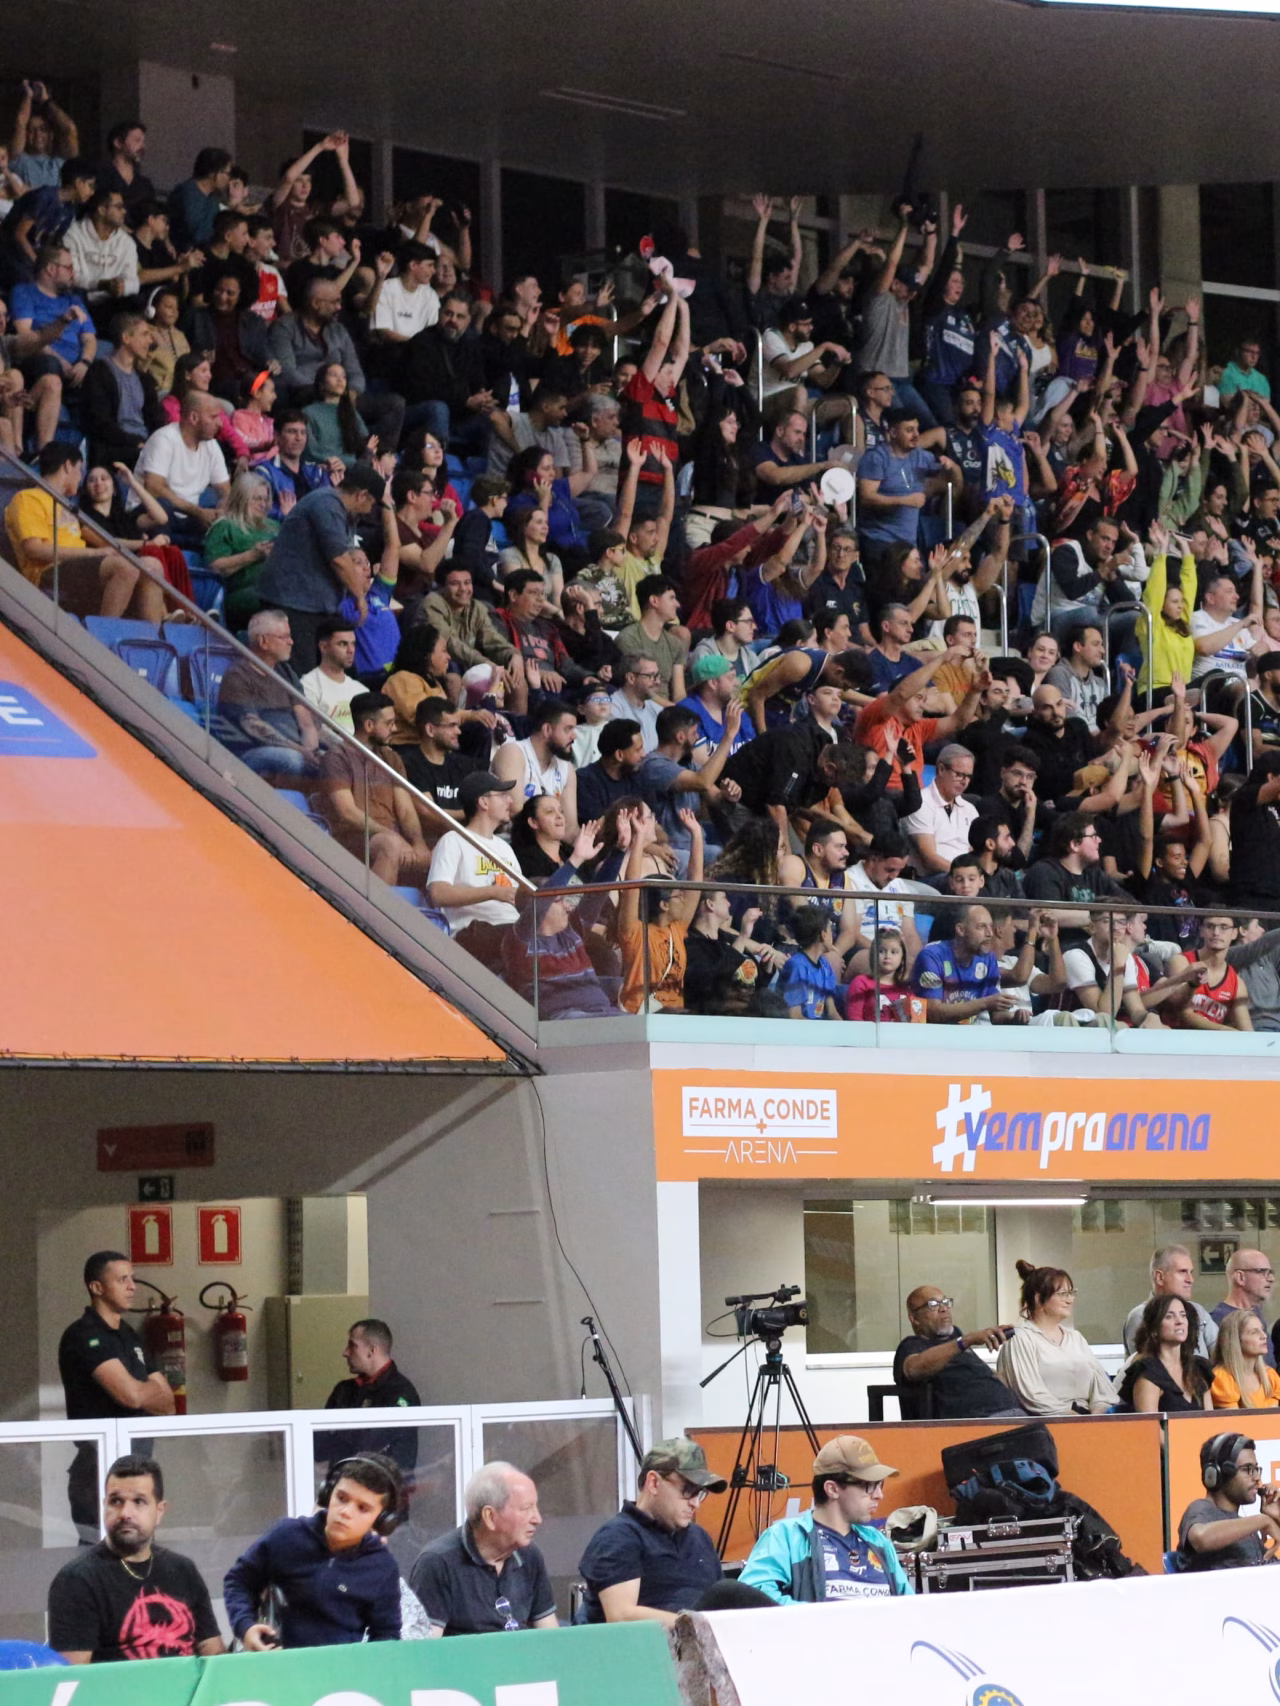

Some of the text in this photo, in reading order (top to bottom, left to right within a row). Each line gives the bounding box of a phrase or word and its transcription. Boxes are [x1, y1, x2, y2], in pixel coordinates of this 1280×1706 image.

[688, 1097, 832, 1122] FARMA CONDE
[932, 1083, 1211, 1172] #vempraarena
[724, 1139, 798, 1164] ARENA
